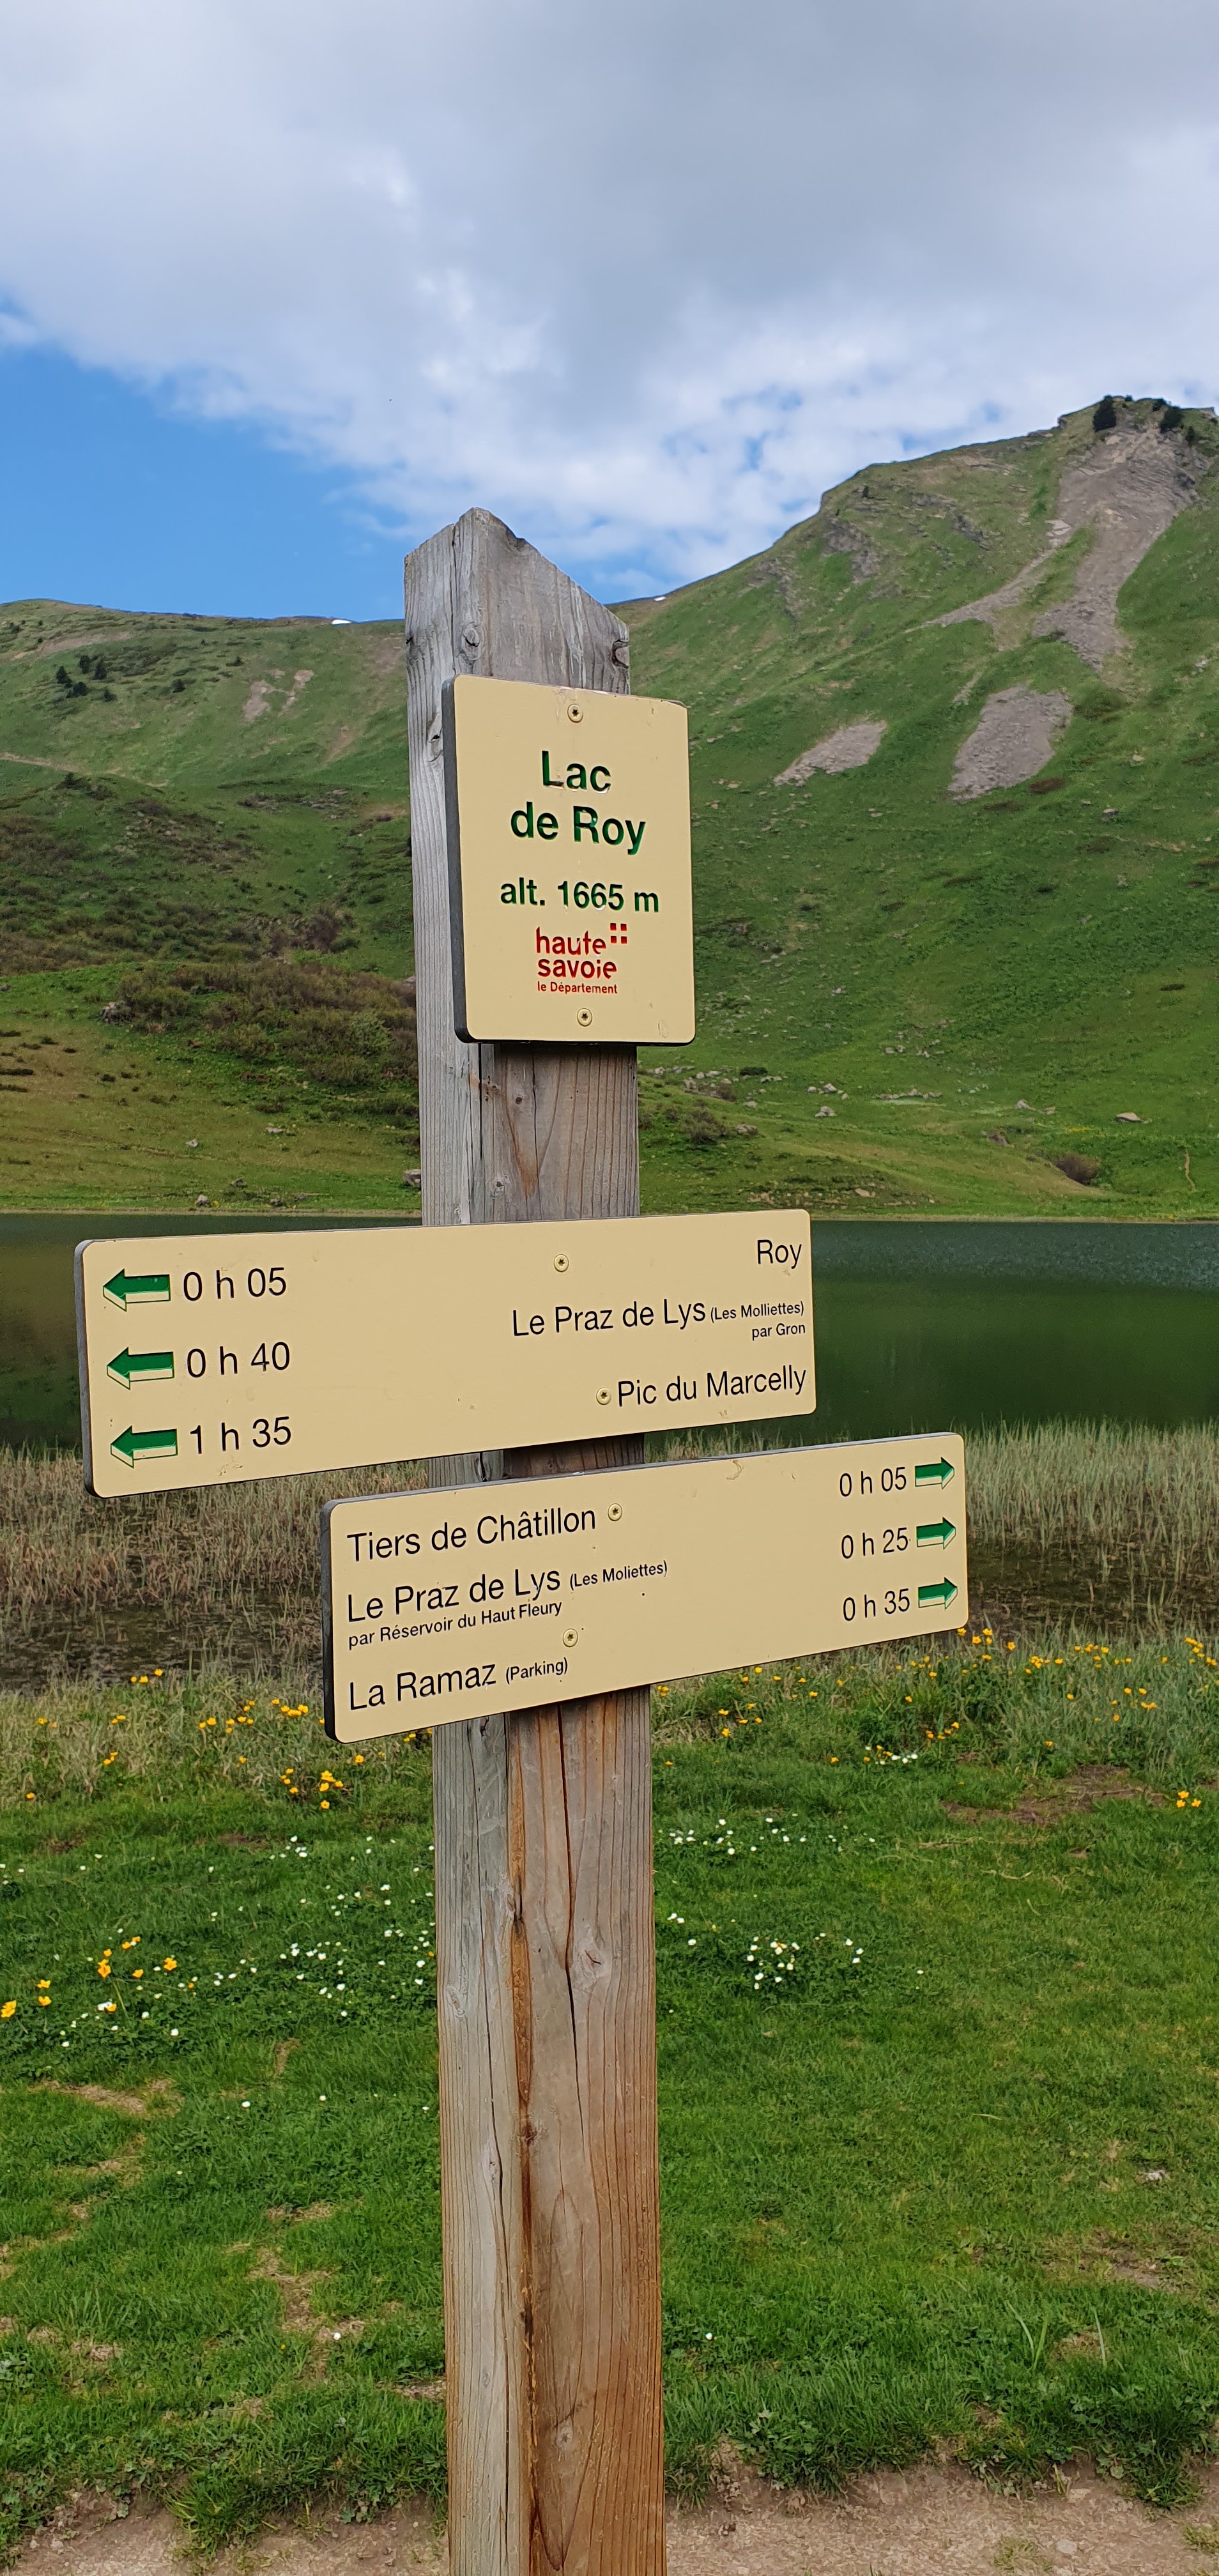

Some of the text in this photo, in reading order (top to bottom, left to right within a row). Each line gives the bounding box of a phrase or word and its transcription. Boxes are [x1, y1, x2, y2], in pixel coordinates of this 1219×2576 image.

[541, 750, 611, 792] Lac
[510, 801, 647, 855] de Roy
[500, 877, 659, 913] alt. 1665 m
[535, 926, 607, 956] haute
[537, 958, 617, 979] savoie
[537, 981, 618, 995] le Département
[757, 1239, 802, 1269] Roy
[183, 1267, 287, 1301] 0 h 05
[512, 1298, 804, 1337] Le Praz de Lys (Les Molliettes)
[751, 1322, 806, 1342] par Gron
[187, 1341, 290, 1378] 0 h 40
[618, 1364, 806, 1407] Pic du Marcelly
[190, 1416, 291, 1455] 1 h 35
[839, 1466, 907, 1498] 0 h 05
[346, 1507, 595, 1562] Tiers de Châtillon
[841, 1527, 908, 1560] 0 h 25
[348, 1560, 668, 1623] Le Praz de Lys (Les Moliettes)
[843, 1588, 910, 1621] 0 h 35
[349, 1602, 562, 1651] par Réservoir du Haut Fleury
[349, 1657, 568, 1711] La Ramaz (Parking)
